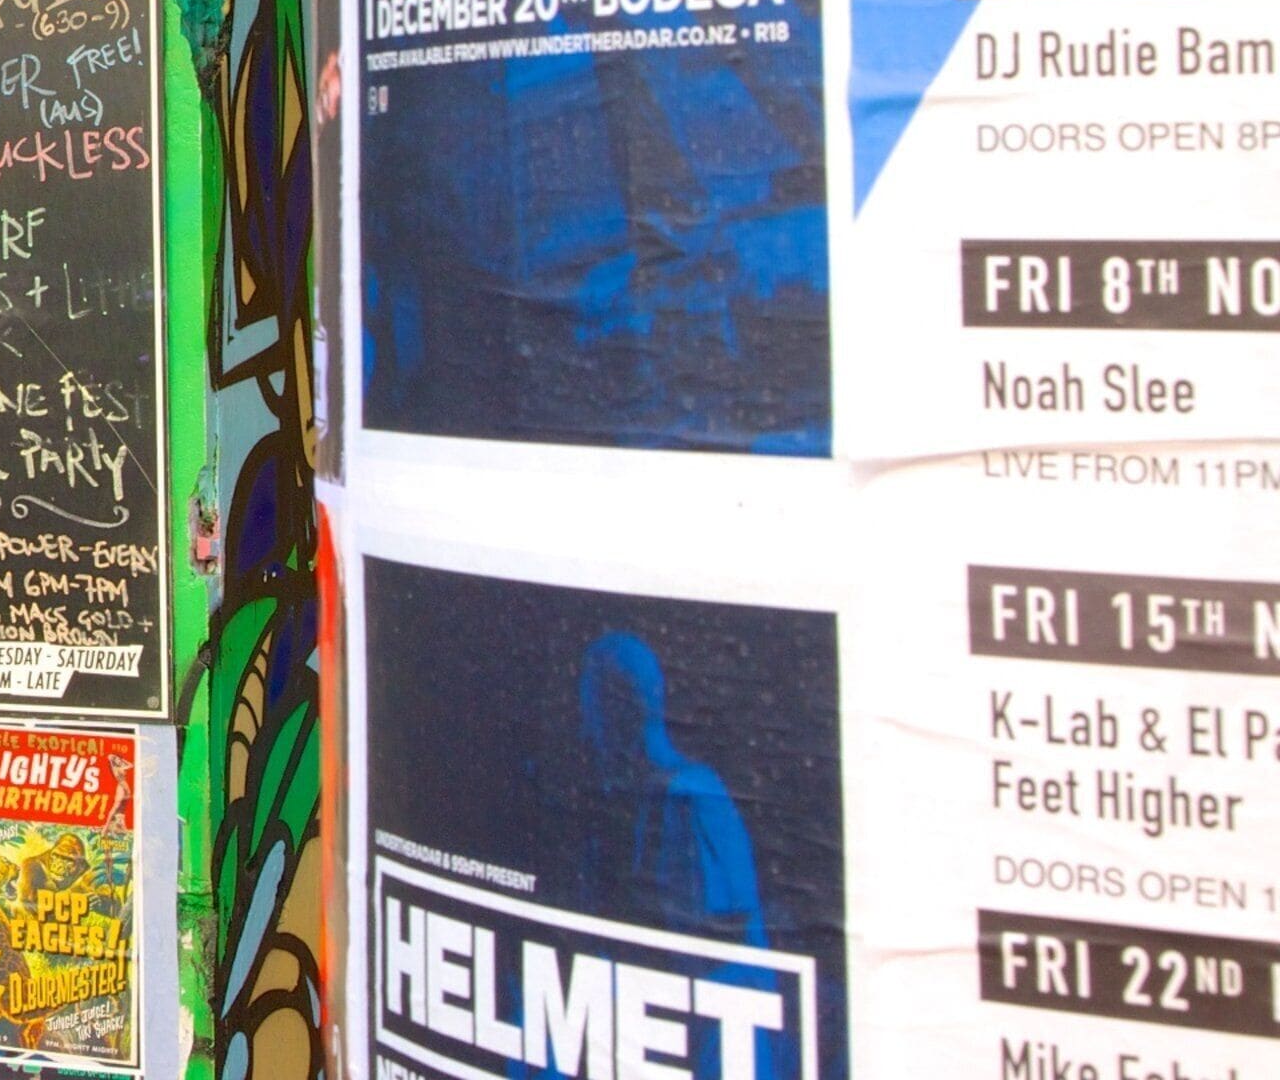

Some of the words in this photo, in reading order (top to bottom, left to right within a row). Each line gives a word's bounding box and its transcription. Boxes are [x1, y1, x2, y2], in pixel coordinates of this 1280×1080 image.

[66, 27, 143, 89] FREE!
[367, 52, 398, 71] TICKETS
[398, 46, 453, 68] AVAILABLE
[453, 41, 488, 63] FROM
[489, 23, 737, 59] WWW.UNDERTHERADAR.CO.NZ
[754, 21, 790, 42] R18
[976, 32, 1020, 80] DJ
[1040, 28, 1158, 79] Rudie
[1177, 27, 1274, 75] Bam
[976, 123, 1106, 153] DOORS
[1121, 122, 1225, 152] OPEN
[984, 256, 1072, 313] FRI
[1102, 257, 1179, 315] 8TH
[983, 361, 1085, 412] Noah
[1103, 363, 1195, 414] Slee
[19, 427, 128, 501] PARTY
[981, 450, 1058, 481] LIVE
[1072, 452, 1179, 484] FROM
[9, 603, 67, 625] MACS
[78, 609, 134, 631] GOLD
[43, 622, 118, 646] BROWN
[990, 583, 1080, 647] FRI
[1110, 592, 1225, 653] 15TH
[27, 671, 62, 692] LATE
[57, 648, 138, 671] SATURDAY
[27, 734, 104, 756] EXOTICA!
[991, 690, 1119, 750] K-Lab
[1188, 706, 1228, 759] El
[992, 760, 1081, 816] Feet
[1096, 770, 1244, 838] Higher
[486, 863, 537, 892] PRESENT
[993, 856, 1125, 898] DOORS
[1138, 871, 1247, 912] OPEN
[38, 889, 88, 924] PCP
[11, 919, 122, 959] EAGLES!
[385, 896, 783, 1080] HELMET
[1000, 931, 1092, 999] FRI
[1122, 946, 1243, 1012] 22ND
